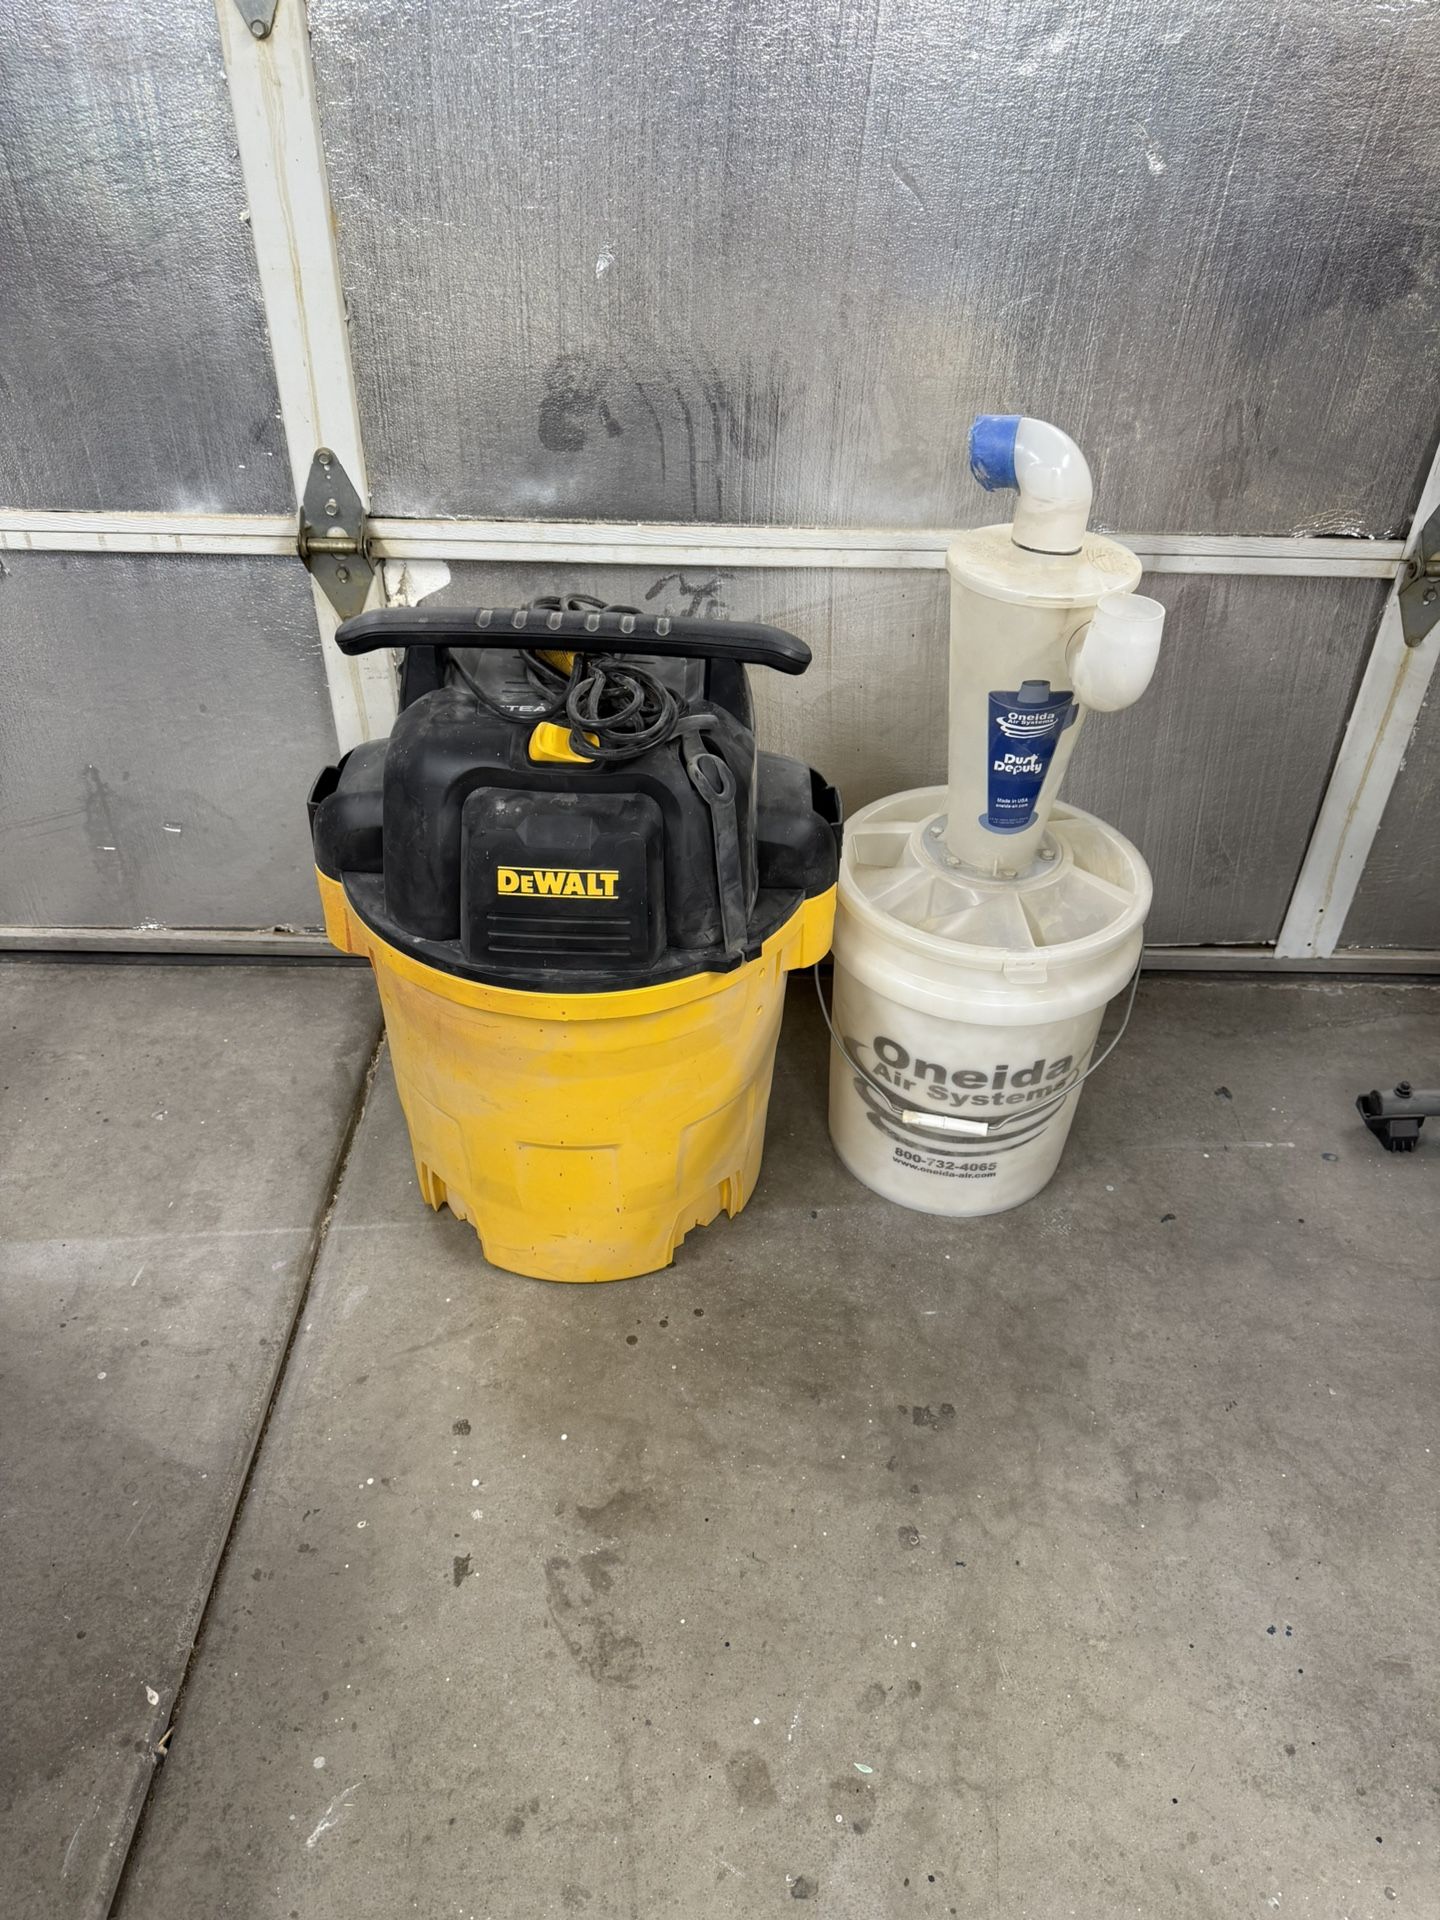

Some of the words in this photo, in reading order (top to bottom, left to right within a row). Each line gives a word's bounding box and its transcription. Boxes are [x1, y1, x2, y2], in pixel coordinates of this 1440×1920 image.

[1008, 712, 1055, 721] Oneida
[993, 760, 1042, 775] Deputy
[1004, 753, 1038, 765] Dust
[873, 1036, 1073, 1090] Oneida
[872, 1062, 916, 1092] Air
[927, 1078, 1066, 1107] Systems
[892, 1156, 996, 1179] www.oneida-air.com
[894, 1147, 998, 1172] 800-732-4065
